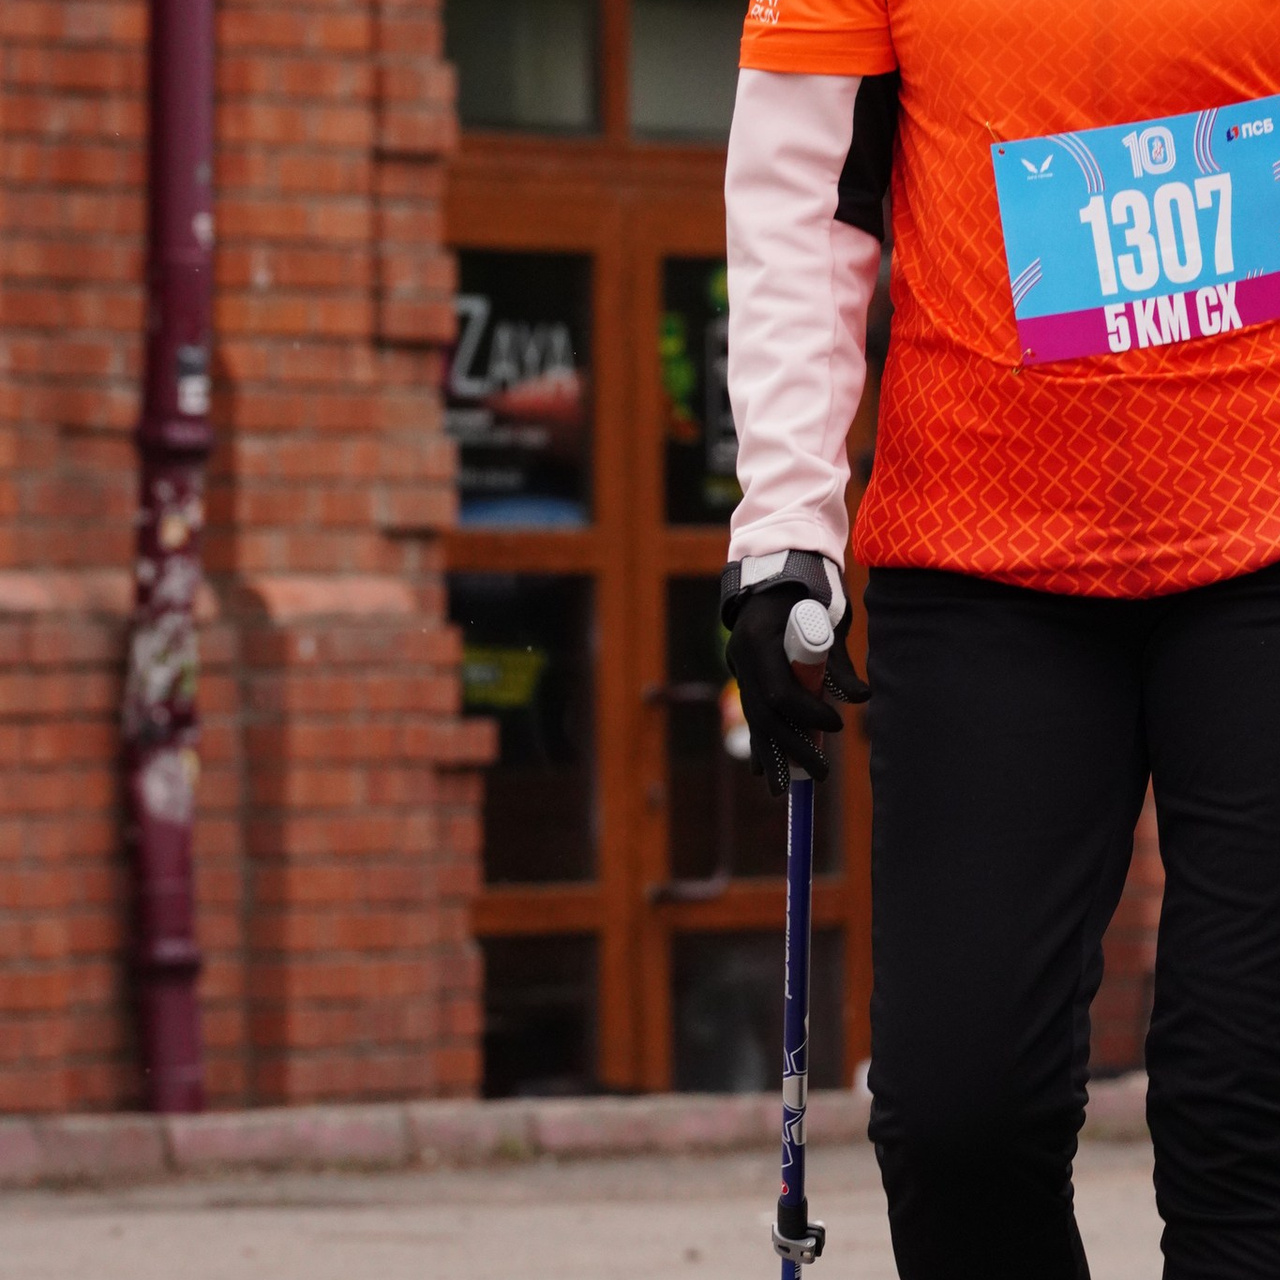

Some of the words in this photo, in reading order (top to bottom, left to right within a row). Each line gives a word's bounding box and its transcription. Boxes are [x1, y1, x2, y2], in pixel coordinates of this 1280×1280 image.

[1121, 126, 1177, 179] 10
[1241, 118, 1275, 139] ПСБ
[1078, 172, 1235, 296] 1307
[1103, 303, 1132, 354] 5
